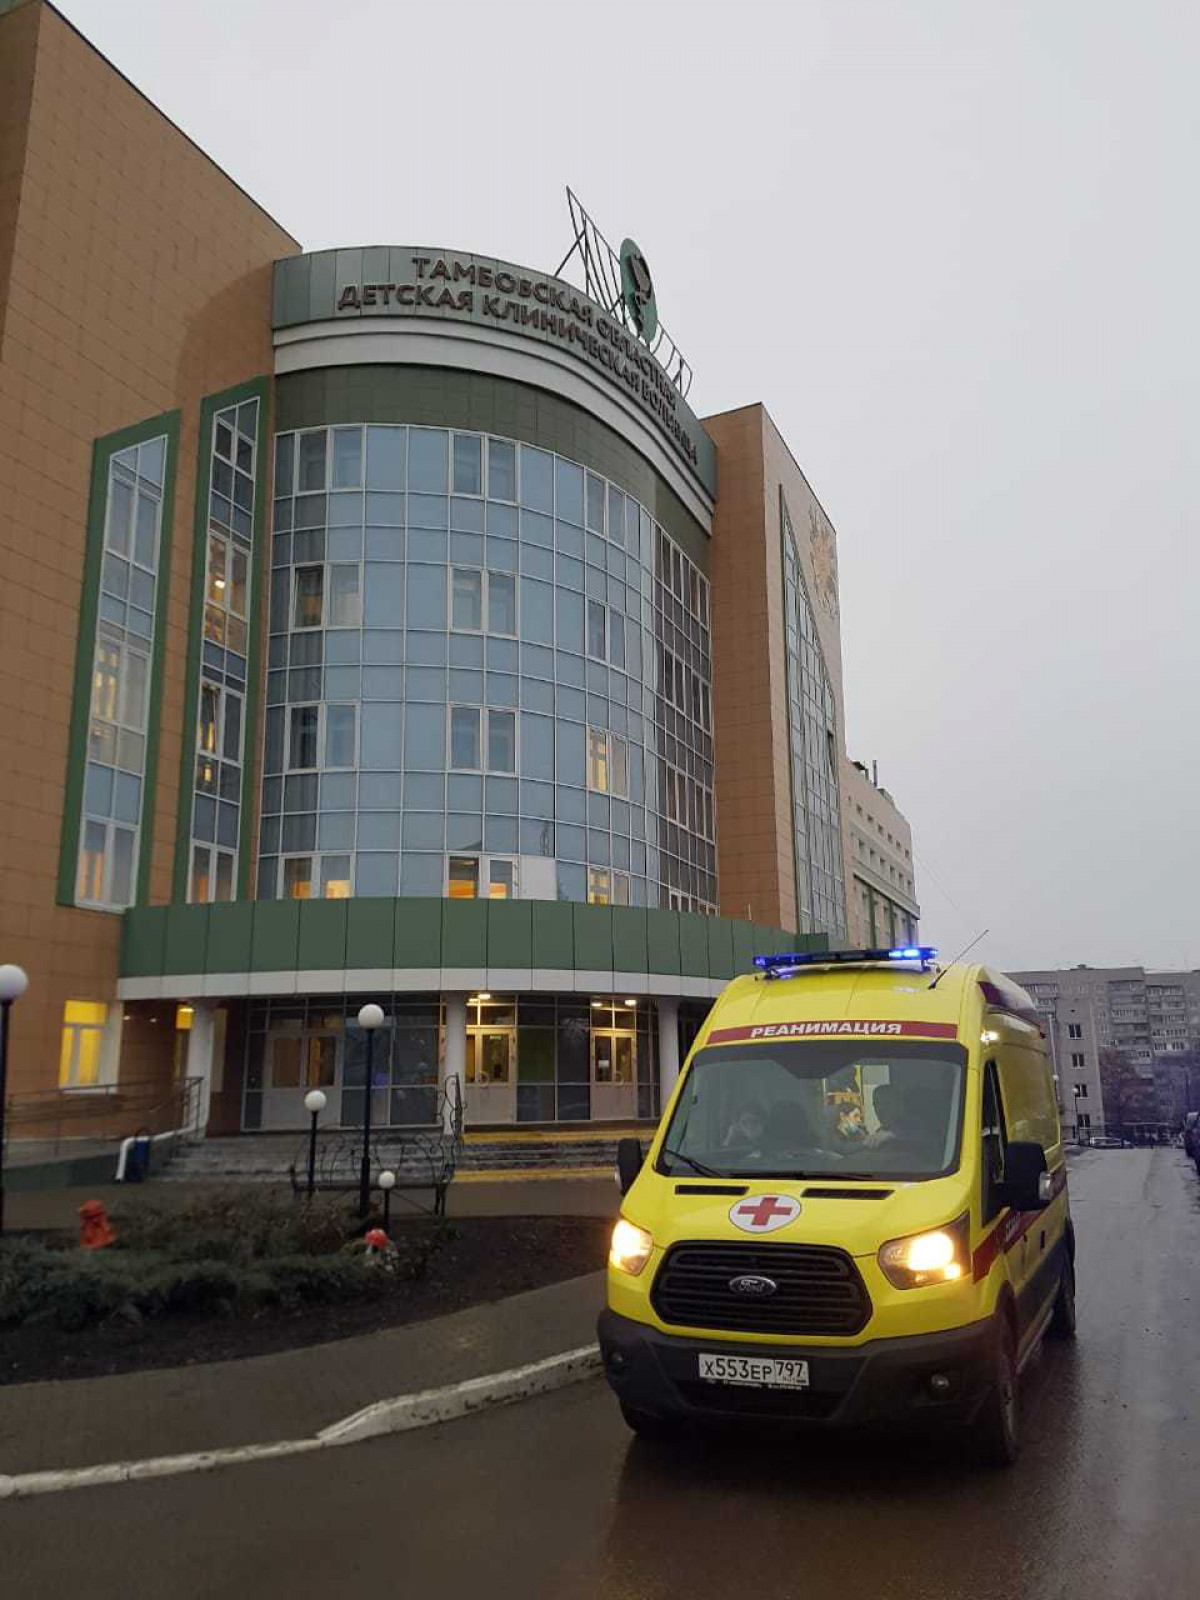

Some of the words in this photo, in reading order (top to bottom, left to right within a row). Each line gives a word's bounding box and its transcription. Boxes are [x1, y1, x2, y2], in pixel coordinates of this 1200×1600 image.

[411, 256, 593, 328] ТАМБОВСКАЯ
[337, 284, 474, 312] ДЕТСКАЯ
[482, 294, 640, 393] КЛИНИЧЕСКАЯ
[750, 1022, 902, 1038] РЕАНИМАЦИЯ
